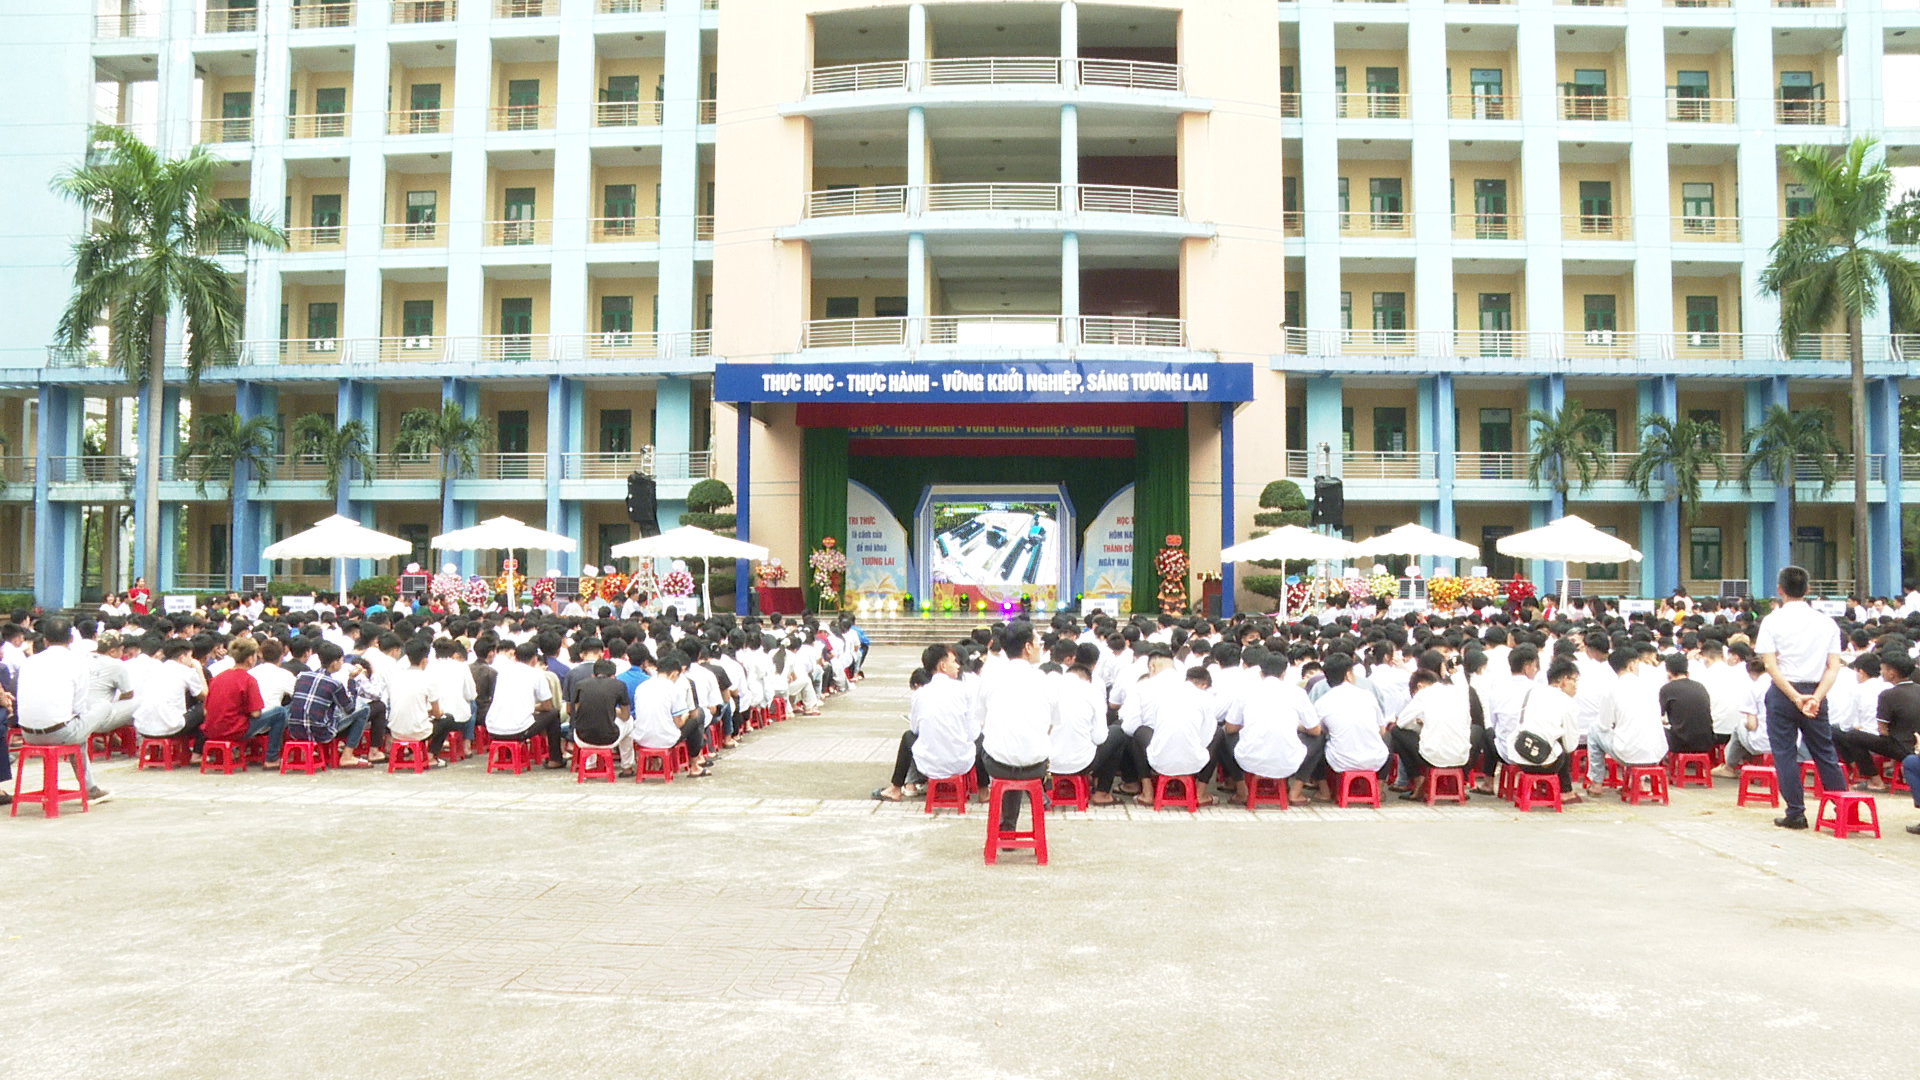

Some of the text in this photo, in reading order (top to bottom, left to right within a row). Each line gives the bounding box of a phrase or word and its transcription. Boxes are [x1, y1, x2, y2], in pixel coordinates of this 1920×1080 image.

[761, 372, 802, 396] THỰC
[803, 373, 835, 396] HỌC
[846, 372, 887, 396] THỰC
[888, 370, 930, 392] HÀNH
[942, 370, 984, 392] VỮNG
[987, 367, 1023, 392] KHỞI
[1026, 370, 1084, 395] NGHIỆP,
[1086, 369, 1129, 392] SÁNG
[1130, 371, 1181, 392] TƯƠNG
[1182, 373, 1208, 391] LAI
[884, 557, 895, 565] LAI
[1117, 558, 1129, 566] MAI
